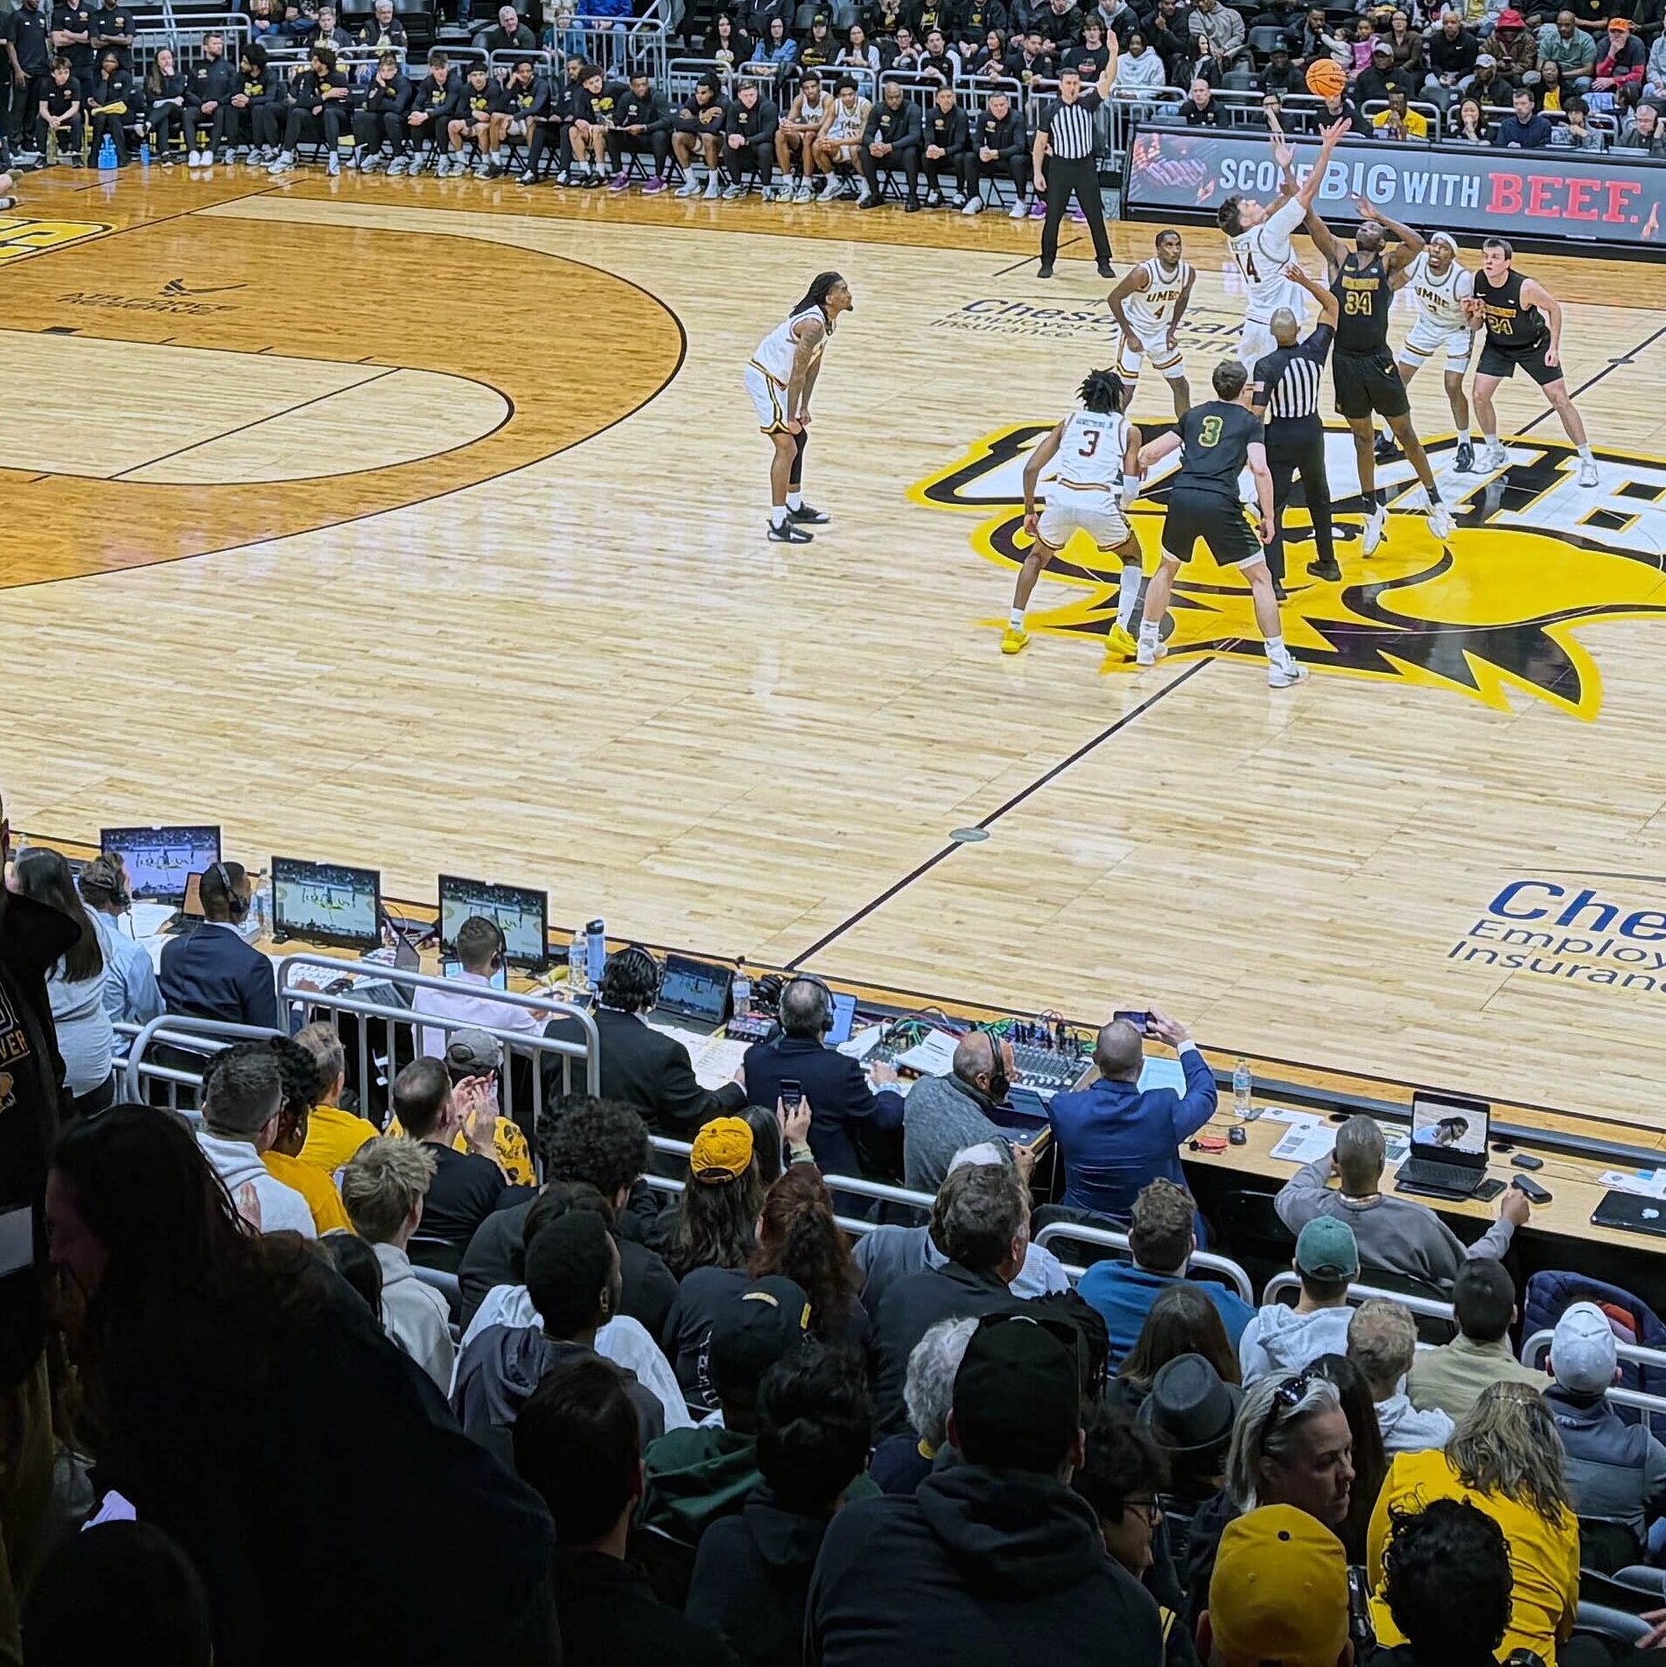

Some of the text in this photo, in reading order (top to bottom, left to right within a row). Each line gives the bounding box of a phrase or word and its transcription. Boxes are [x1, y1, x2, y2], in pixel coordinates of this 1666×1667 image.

[1315, 158, 1398, 204] BIG
[1403, 172, 1481, 209] WITH
[1487, 171, 1641, 224] BEEF.
[1234, 252, 1262, 284] 14
[1146, 289, 1183, 304] UMBC
[1343, 290, 1373, 316] 34
[1414, 285, 1451, 309] UMBC
[1153, 304, 1167, 320] 4
[1077, 429, 1101, 458] 3
[1197, 414, 1224, 448] 3
